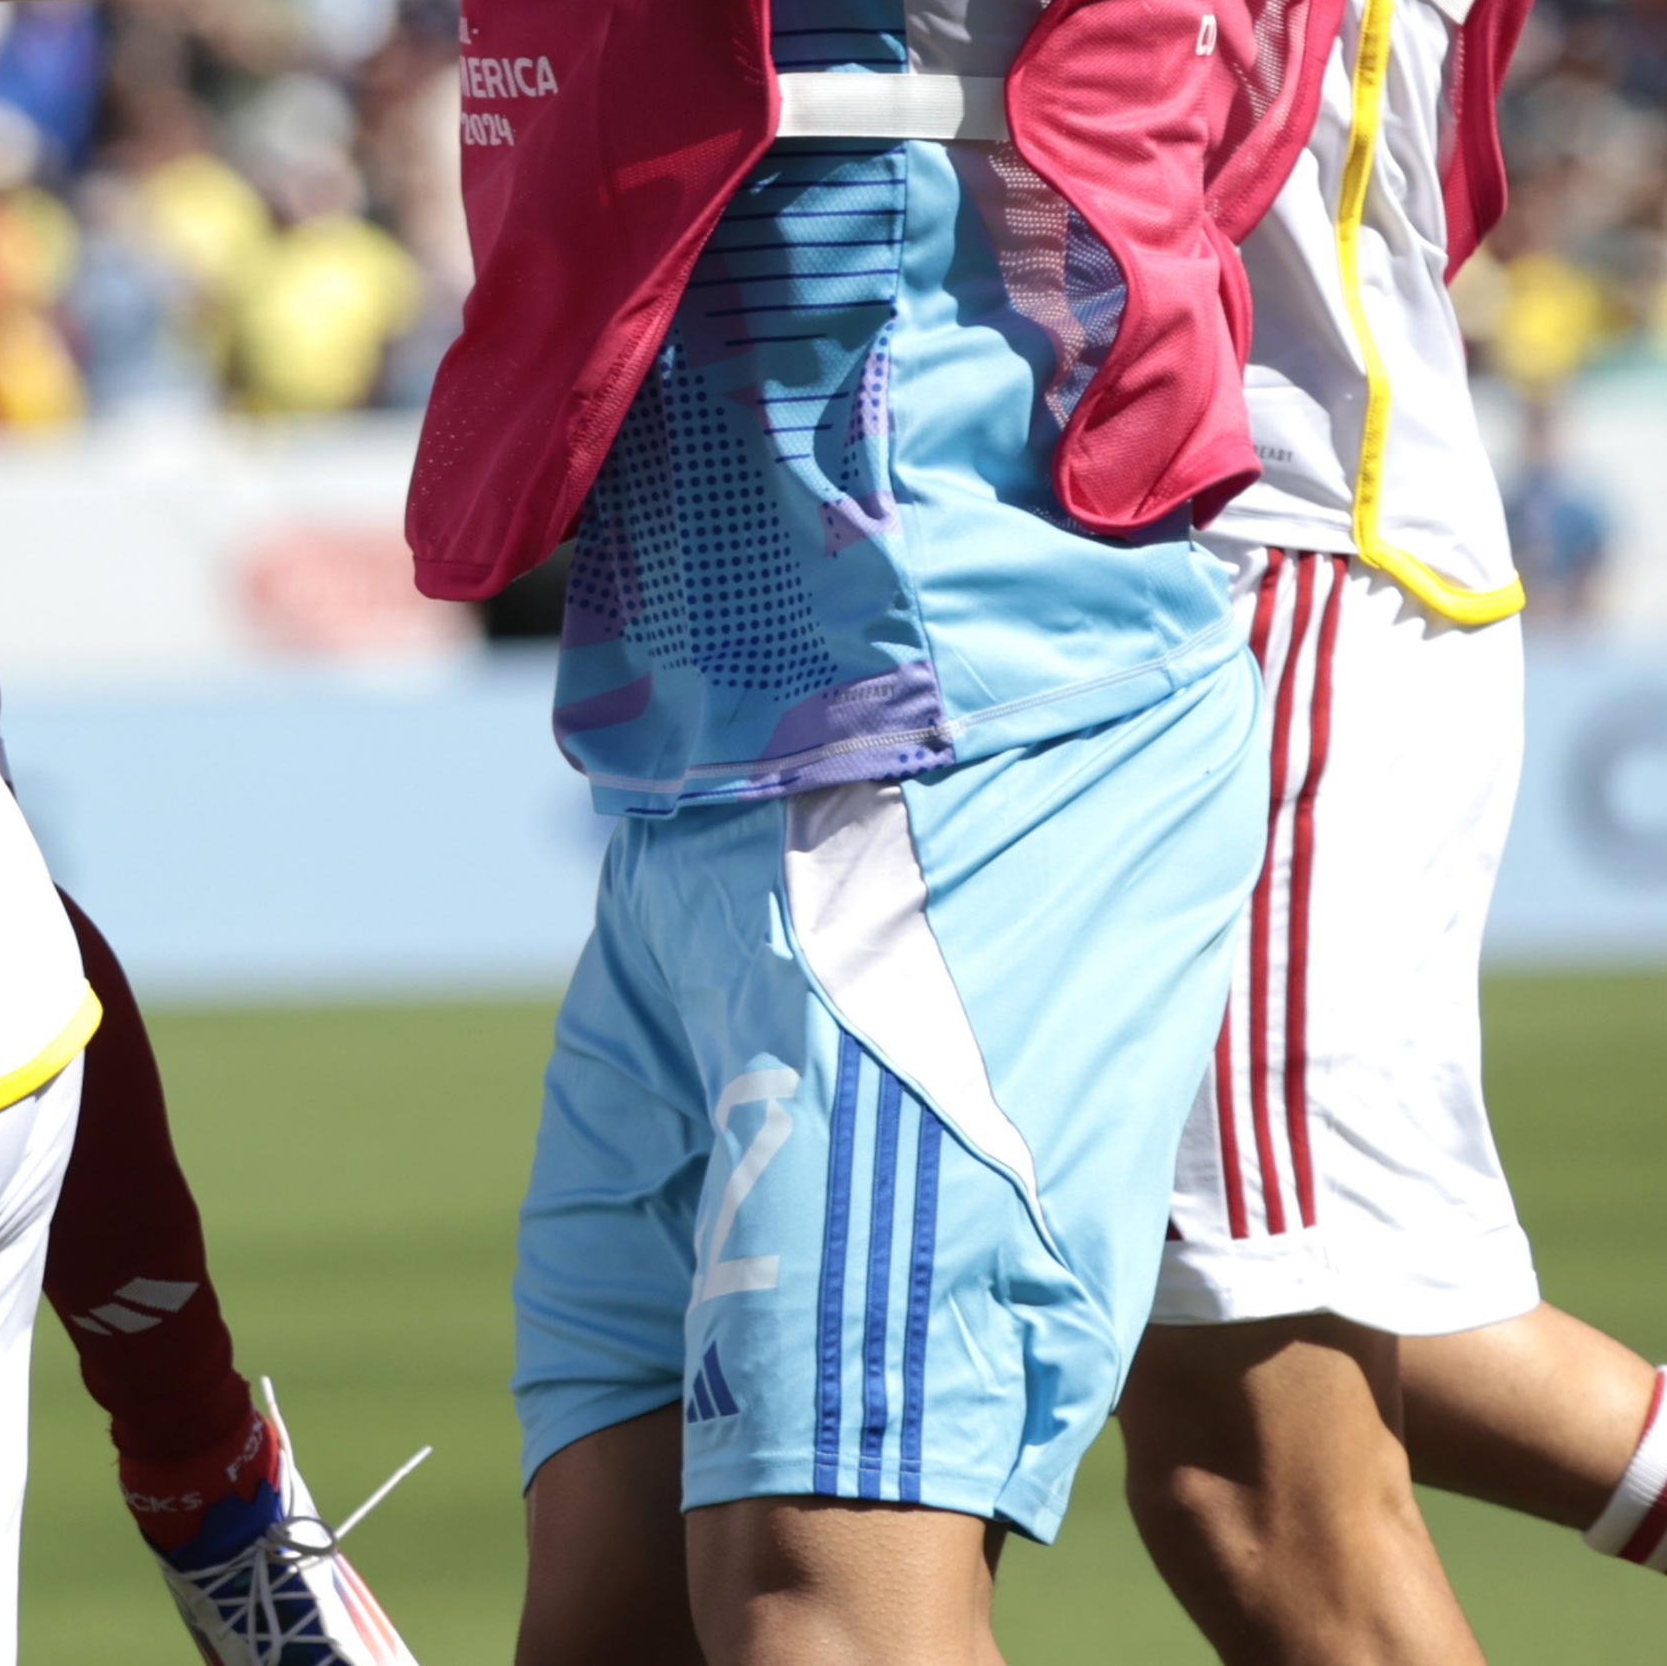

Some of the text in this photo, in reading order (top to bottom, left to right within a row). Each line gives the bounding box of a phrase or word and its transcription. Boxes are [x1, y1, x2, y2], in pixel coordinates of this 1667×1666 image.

[461, 112, 515, 147] 2024
[697, 1068, 799, 1304] 2
[126, 1490, 204, 1514] CKS
